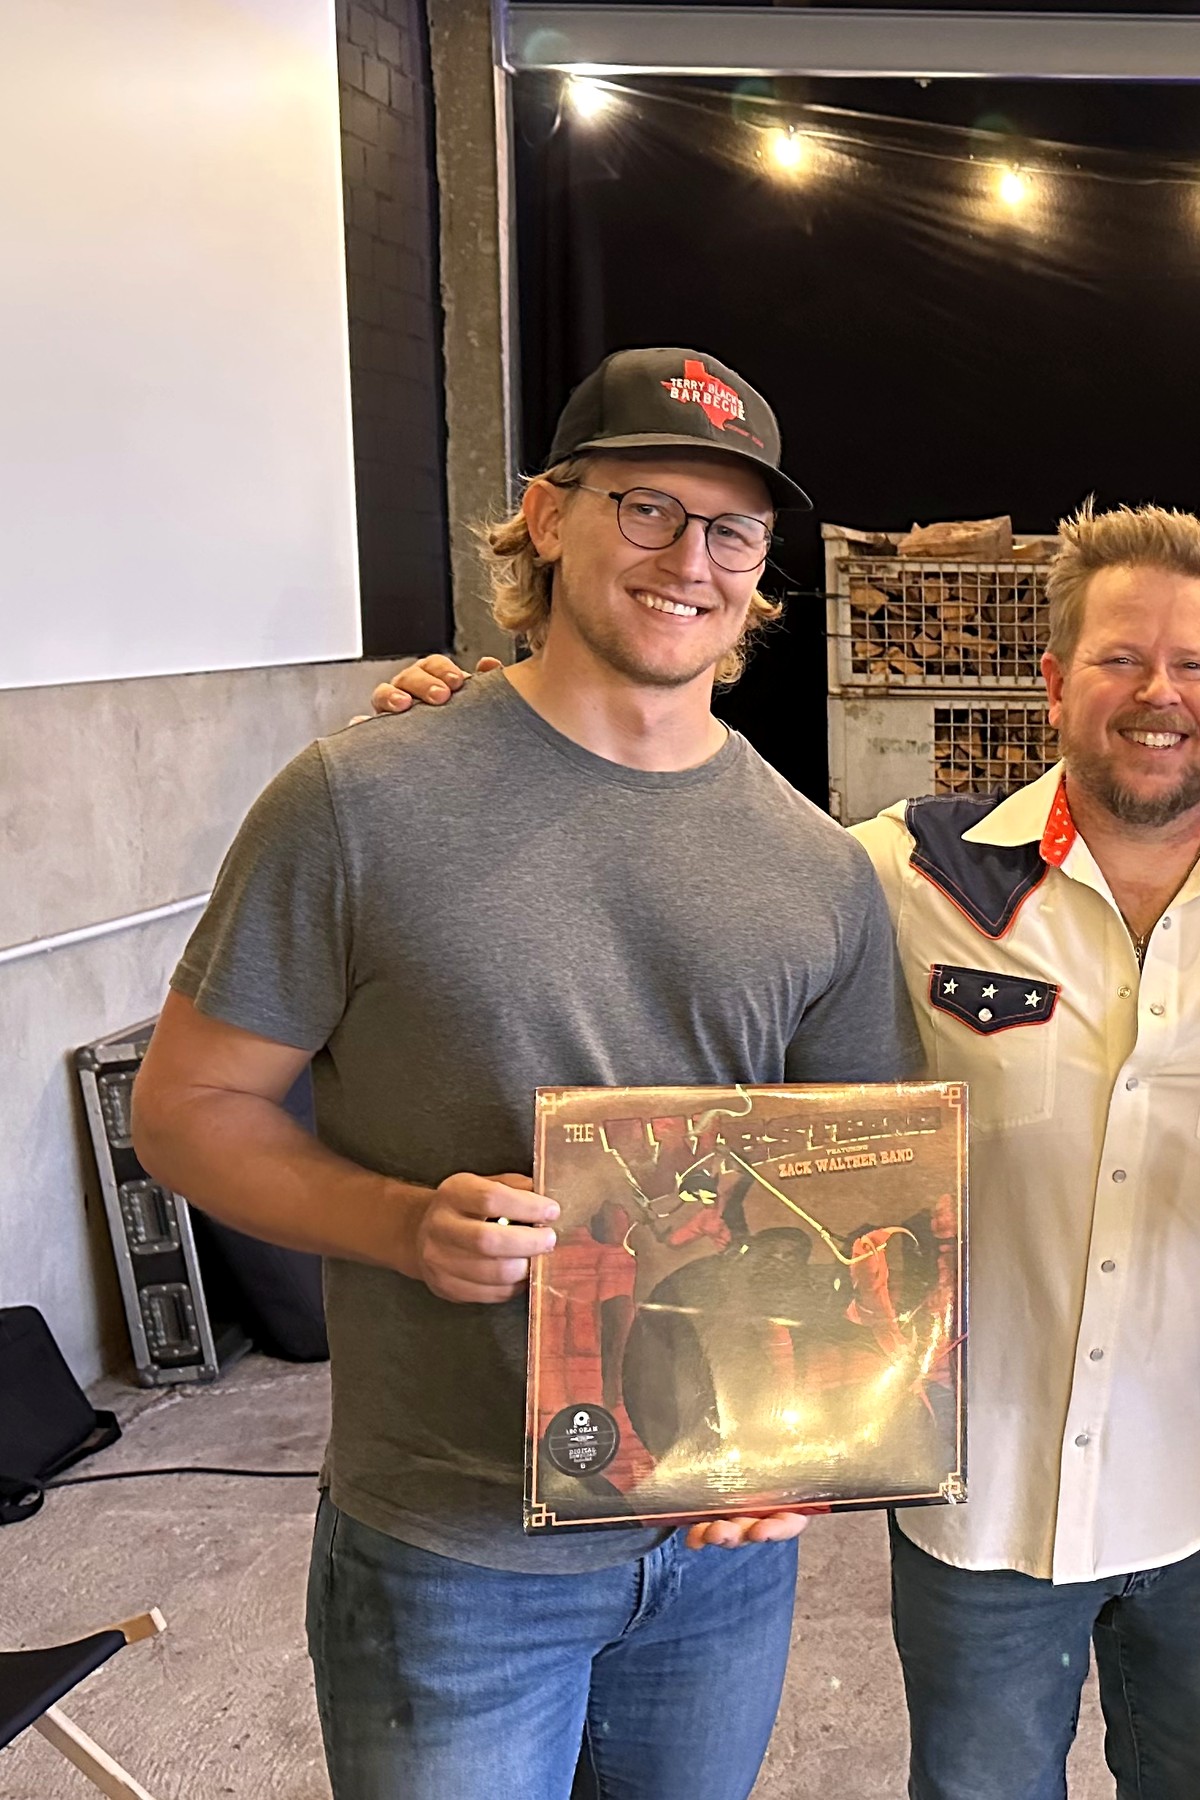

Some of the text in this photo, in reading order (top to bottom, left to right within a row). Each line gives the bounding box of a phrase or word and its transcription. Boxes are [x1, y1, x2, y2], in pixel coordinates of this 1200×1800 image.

[669, 378, 706, 392] TERRY
[669, 387, 747, 422] BARBECUE
[563, 1123, 595, 1143] THE
[778, 1147, 914, 1178] ZACK WALTHER BAND
